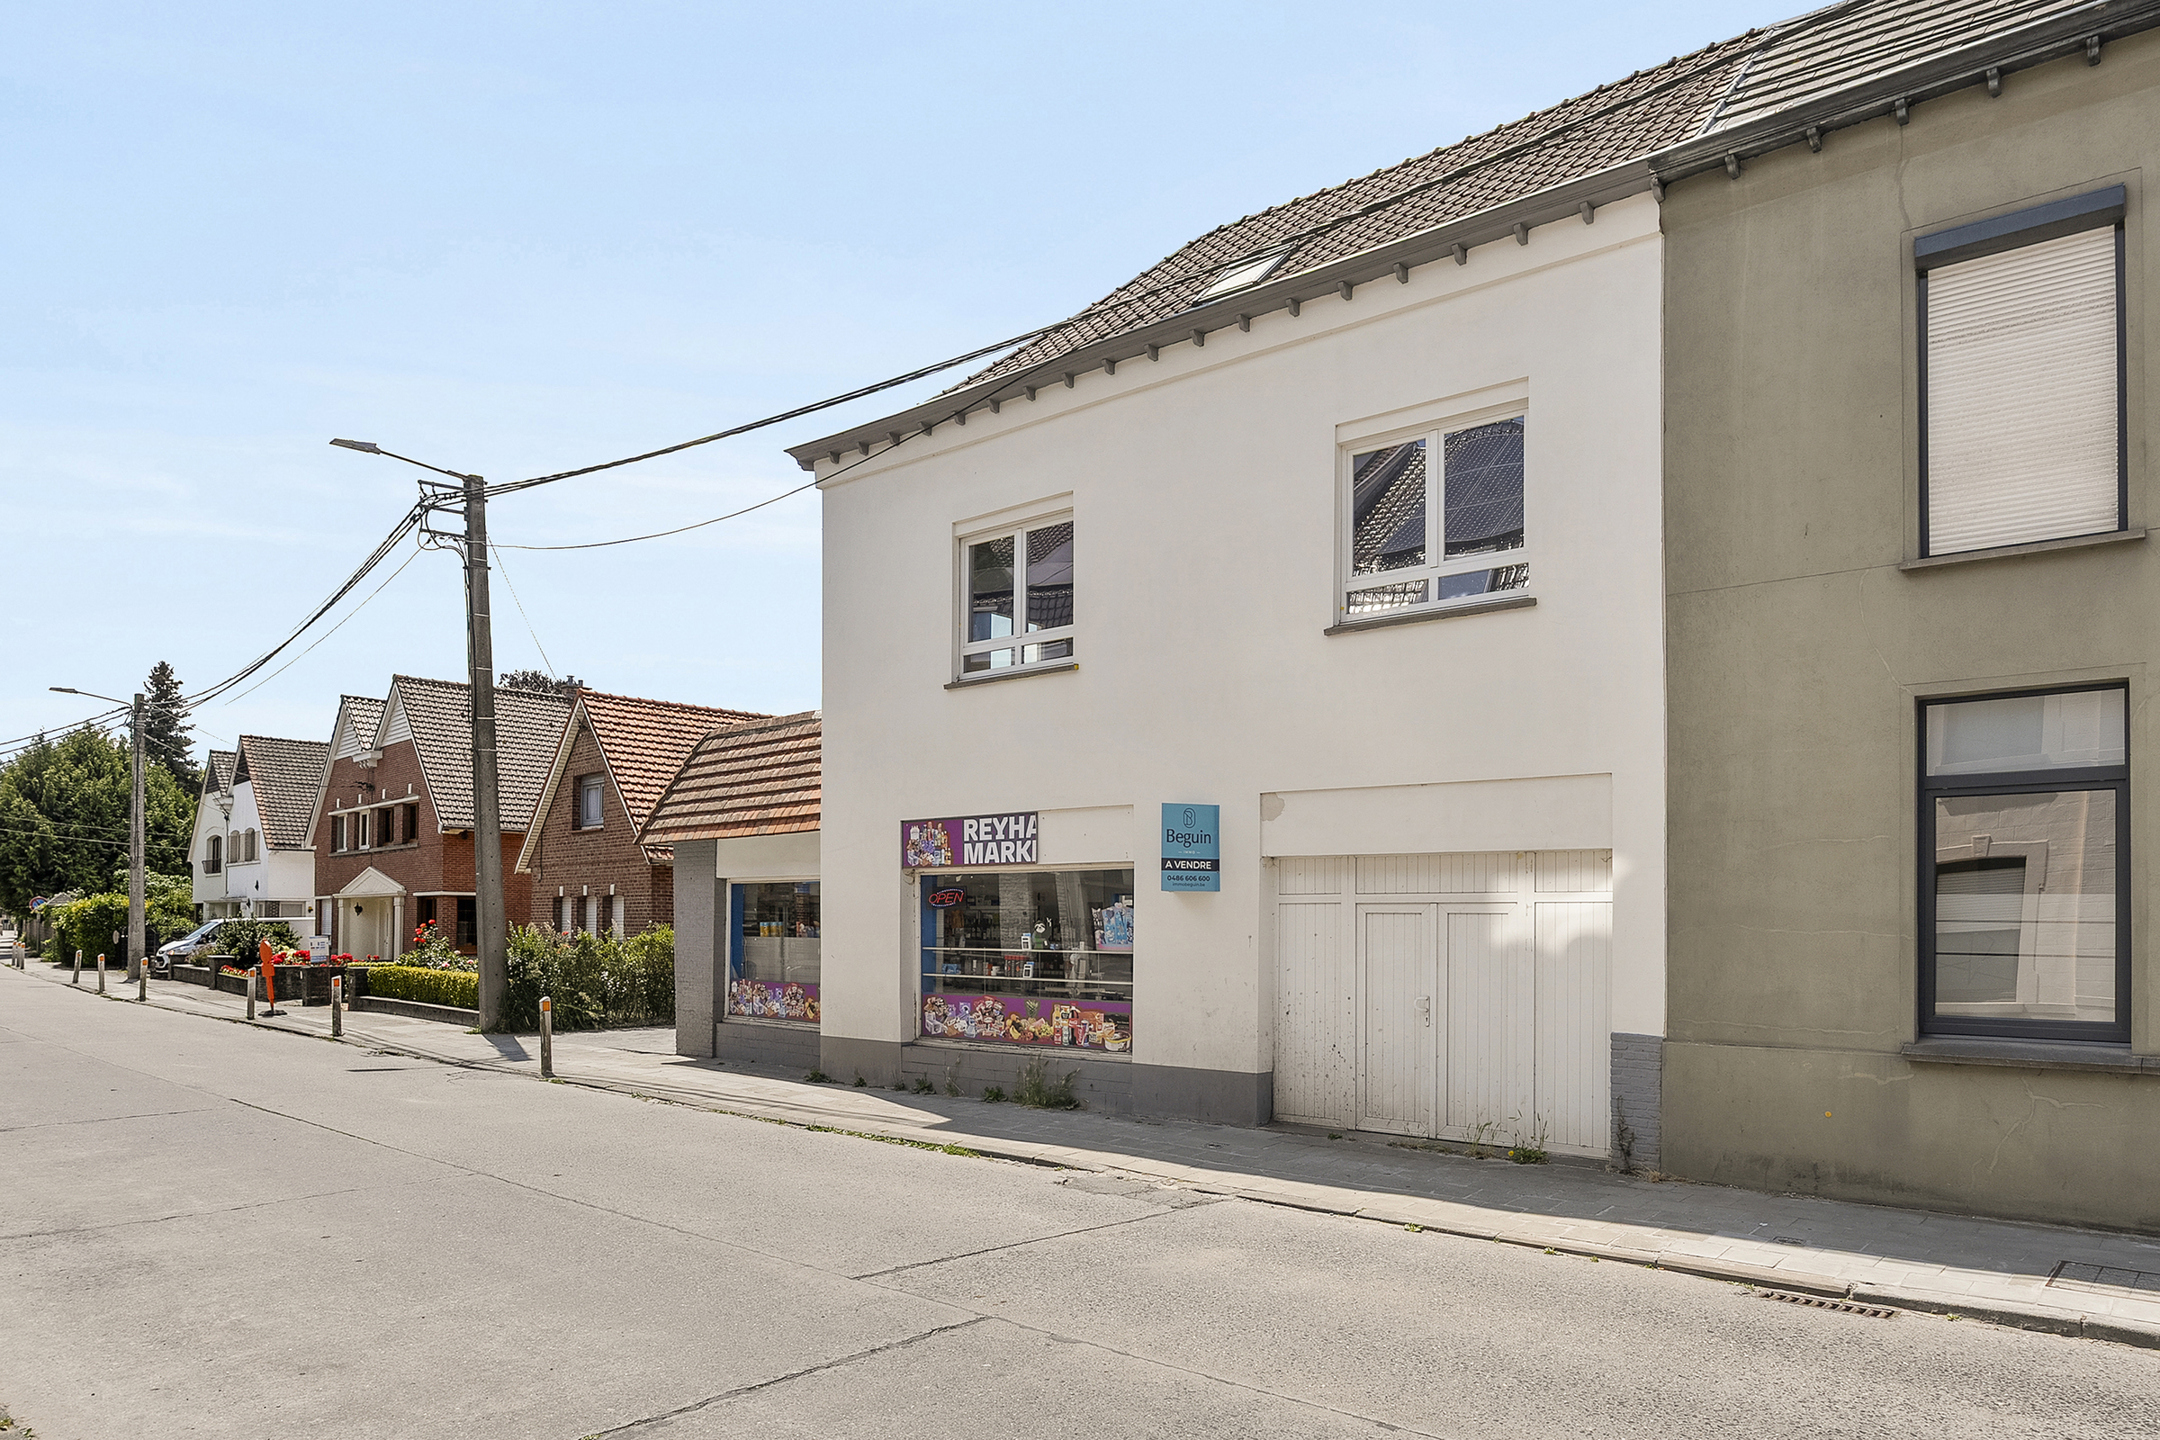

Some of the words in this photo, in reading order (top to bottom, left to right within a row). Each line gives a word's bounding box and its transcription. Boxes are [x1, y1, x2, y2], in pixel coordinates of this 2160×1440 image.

[1166, 829, 1211, 848] Beguin
[1165, 860, 1172, 868] A
[1174, 860, 1211, 869] VENDRE
[928, 892, 965, 904] OPEN
